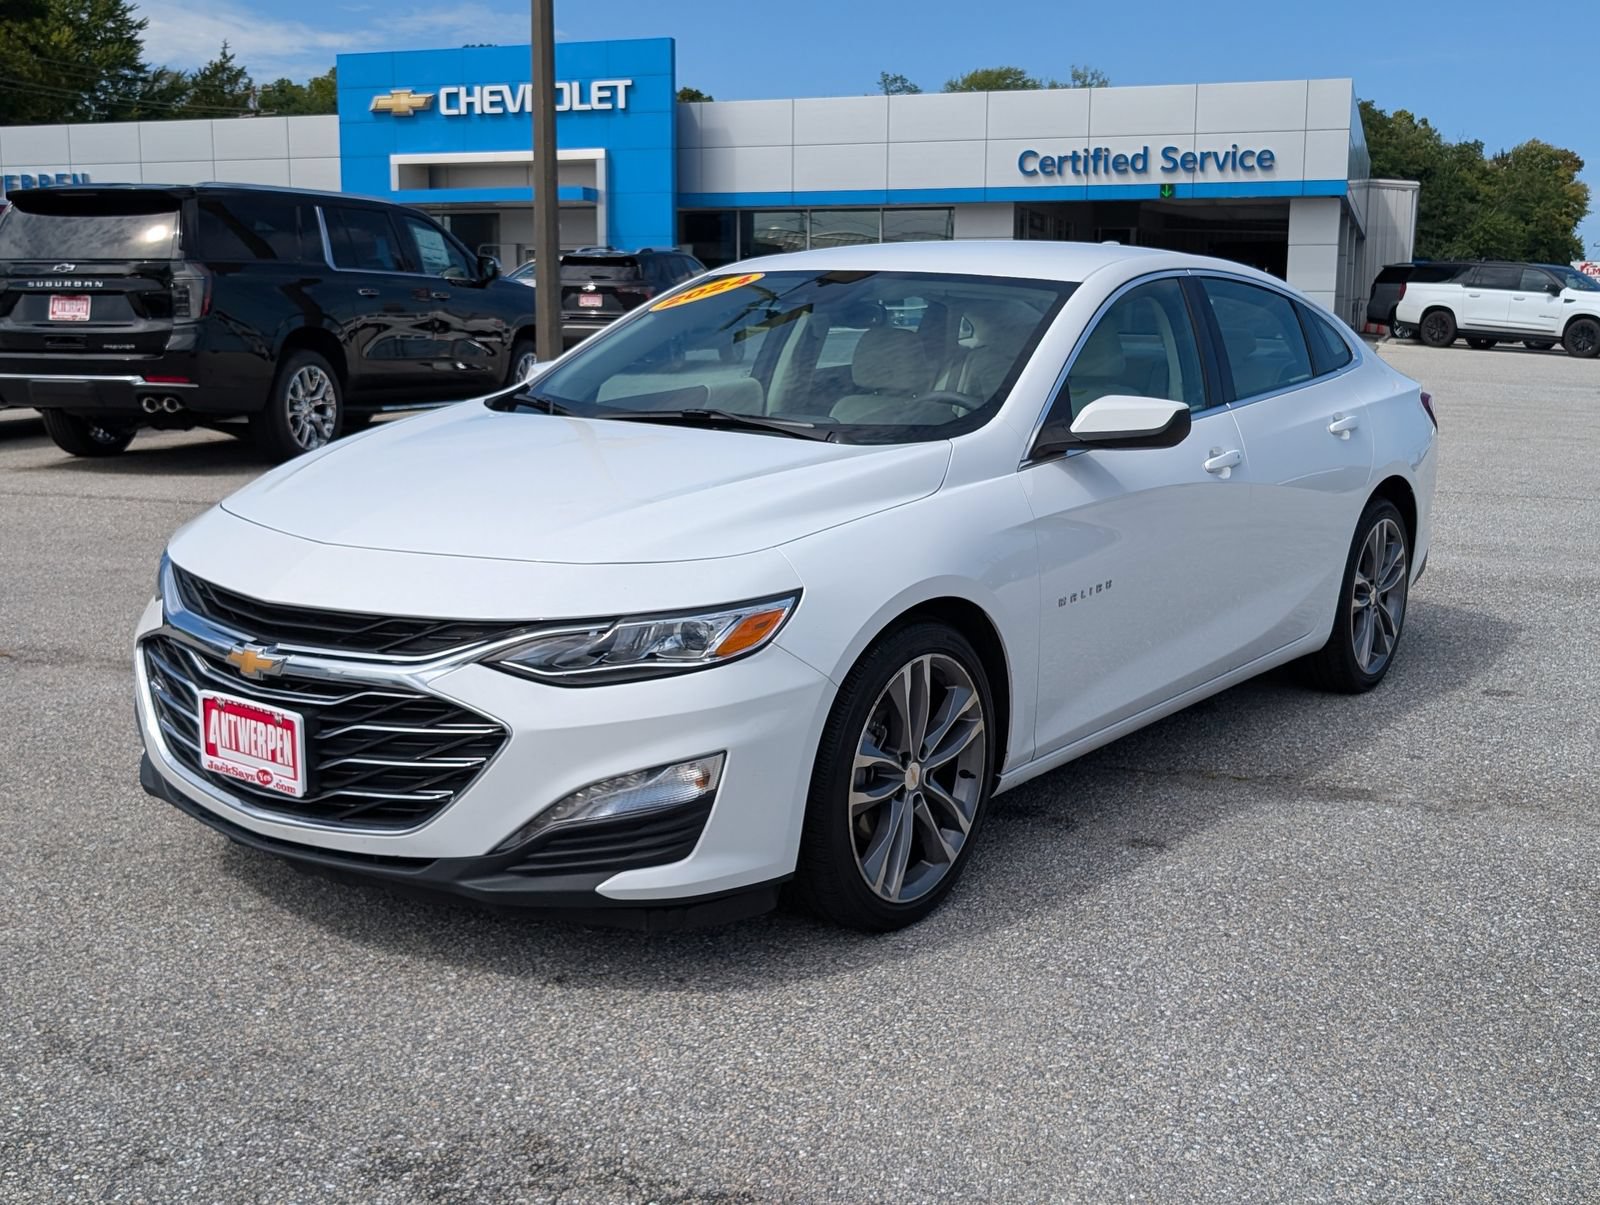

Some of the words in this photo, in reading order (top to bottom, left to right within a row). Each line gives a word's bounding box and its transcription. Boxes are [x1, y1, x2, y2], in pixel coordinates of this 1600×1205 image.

[1018, 146, 1149, 177] Certified
[1160, 144, 1275, 174] Service
[27, 280, 104, 288] SUBURBAN
[1058, 579, 1113, 608] MALIBU
[208, 709, 294, 768] ANTWERPEN
